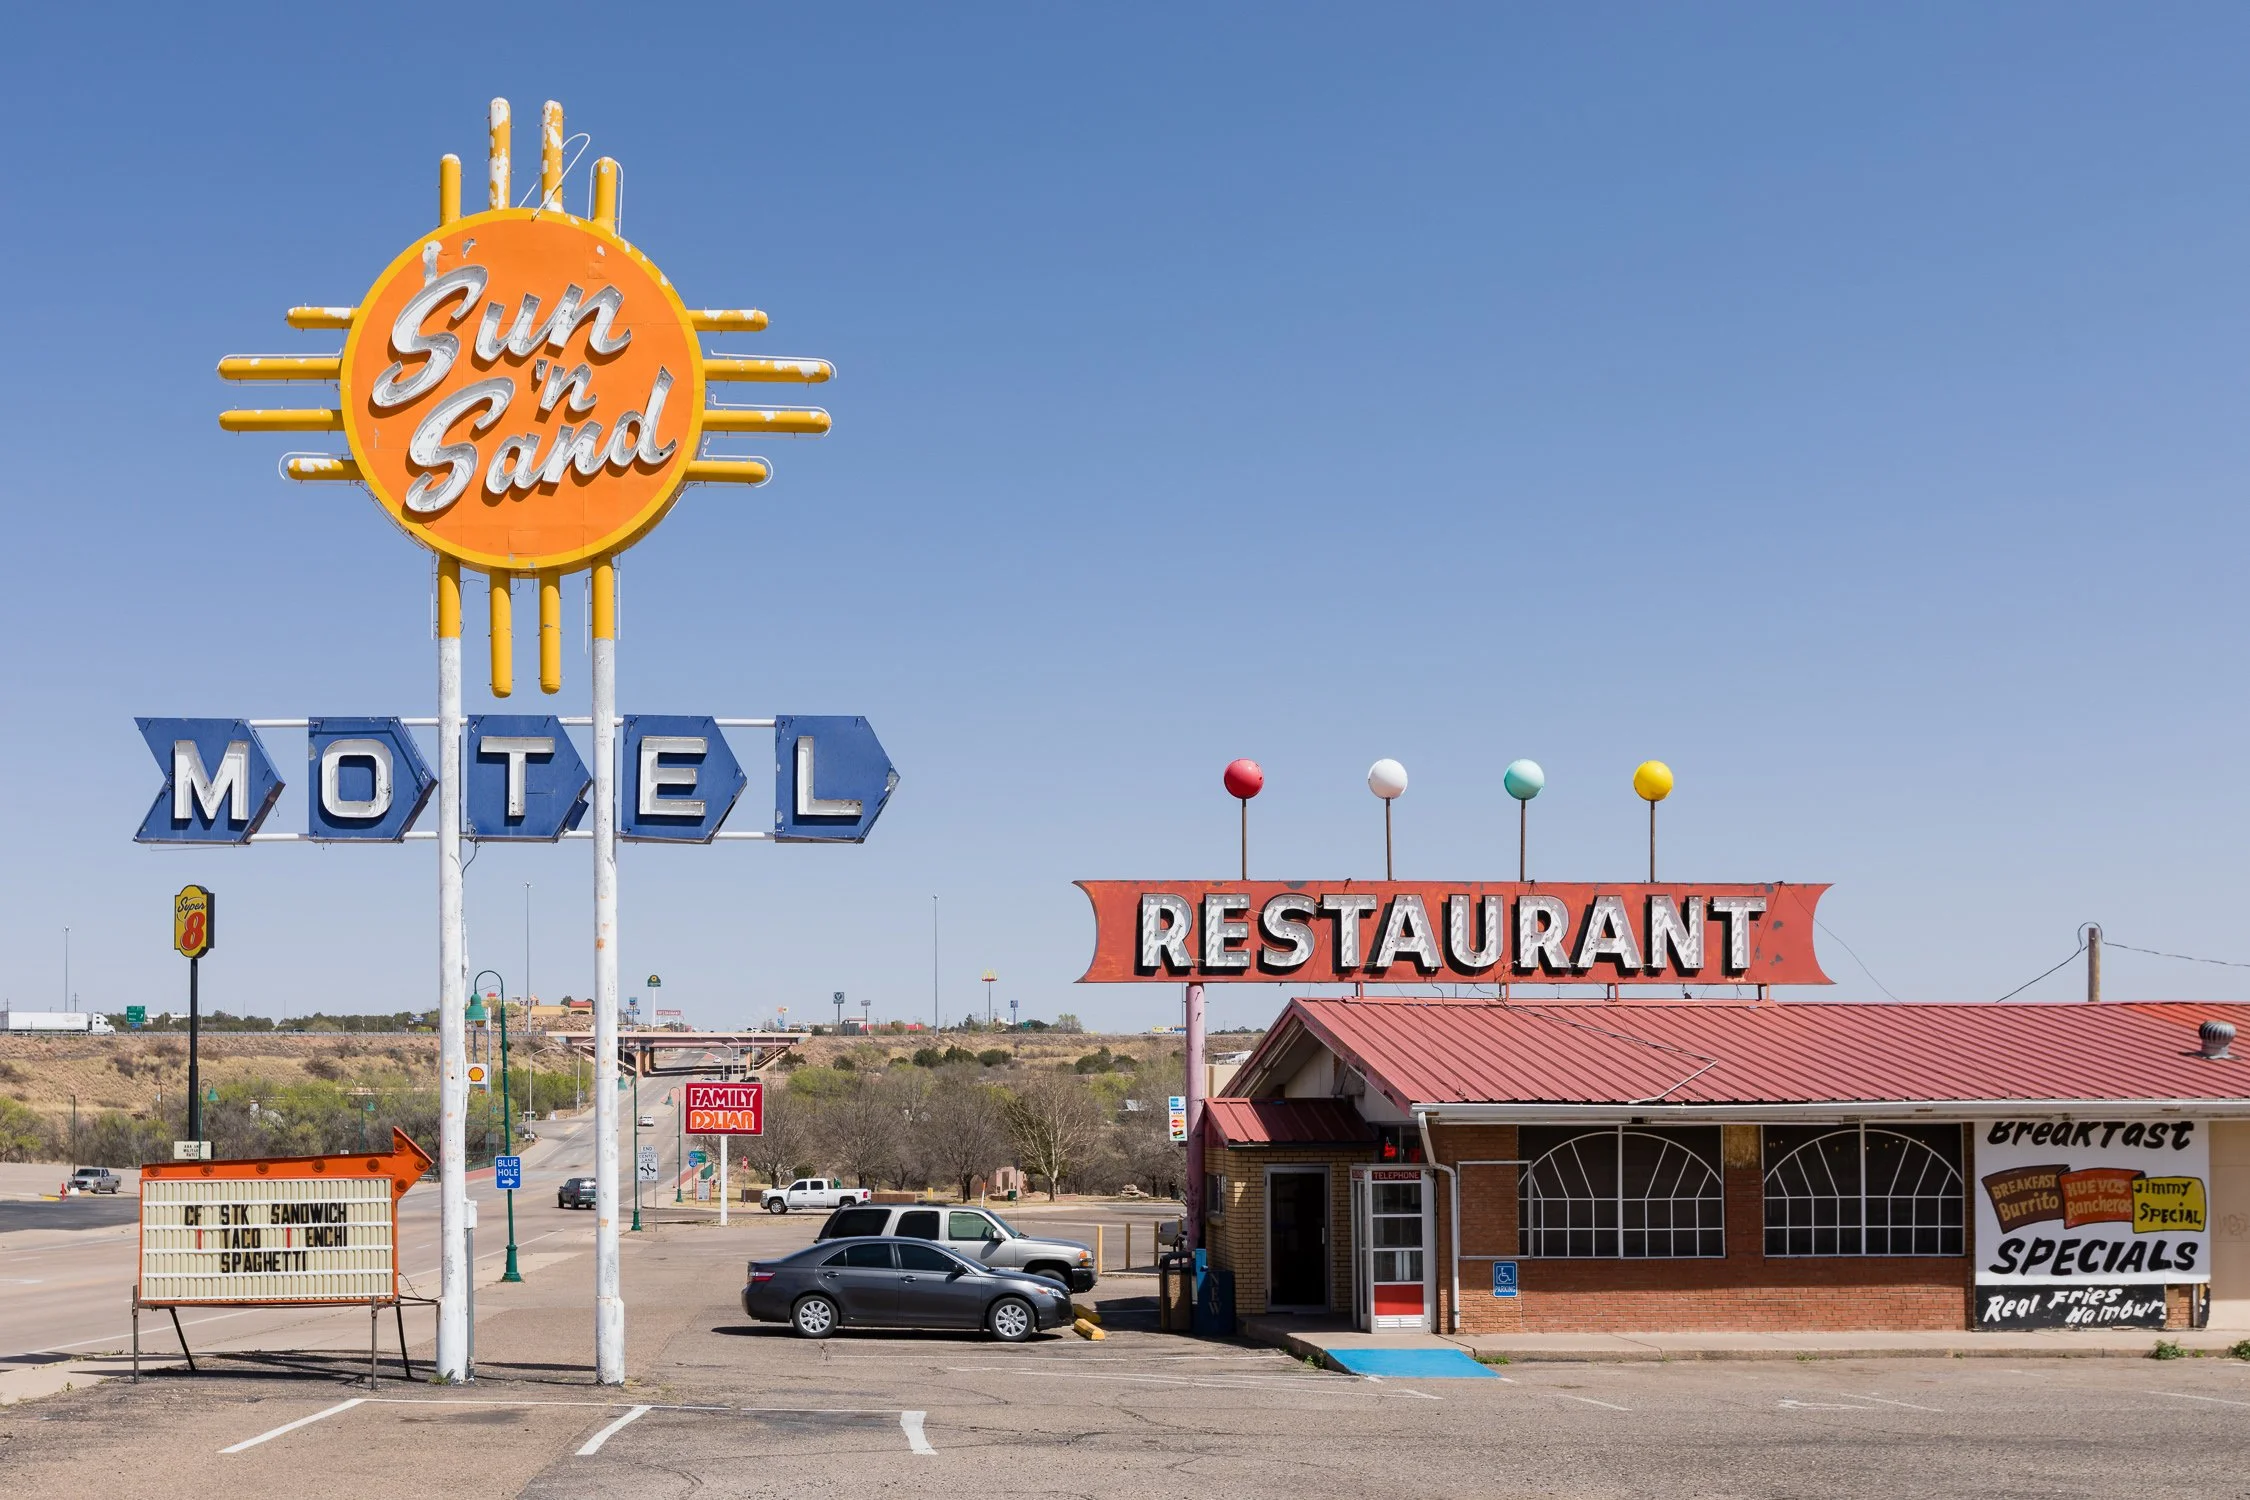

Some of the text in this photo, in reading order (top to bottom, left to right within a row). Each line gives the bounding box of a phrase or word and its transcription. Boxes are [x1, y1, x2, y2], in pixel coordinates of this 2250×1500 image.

[372, 264, 632, 408] Sun
[406, 365, 677, 513] Sand
[174, 736, 864, 820] MOTEL
[178, 896, 205, 919] Super
[180, 912, 205, 951] 8
[1139, 894, 1767, 972] RESTAURANT
[690, 1088, 757, 1108] FAMILY
[690, 1110, 754, 1130] DOLLAR
[498, 1159, 518, 1167] BLUE
[1373, 1171, 1420, 1180] TELEPHONE
[1991, 1174, 2058, 1200] BREAKFAST
[2066, 1178, 2129, 1198] HUEVOS
[184, 1202, 347, 1226] CF STK SANDWICH
[1998, 1191, 2059, 1222] Burrito
[2066, 1197, 2132, 1219] Rancheros
[220, 1228, 261, 1249] TACO
[305, 1226, 347, 1248] ENCHI
[220, 1251, 306, 1273] SPAGHETTI
[1988, 1237, 2199, 1276] SPECIALS
[1983, 1287, 2123, 1322] Real Fries
